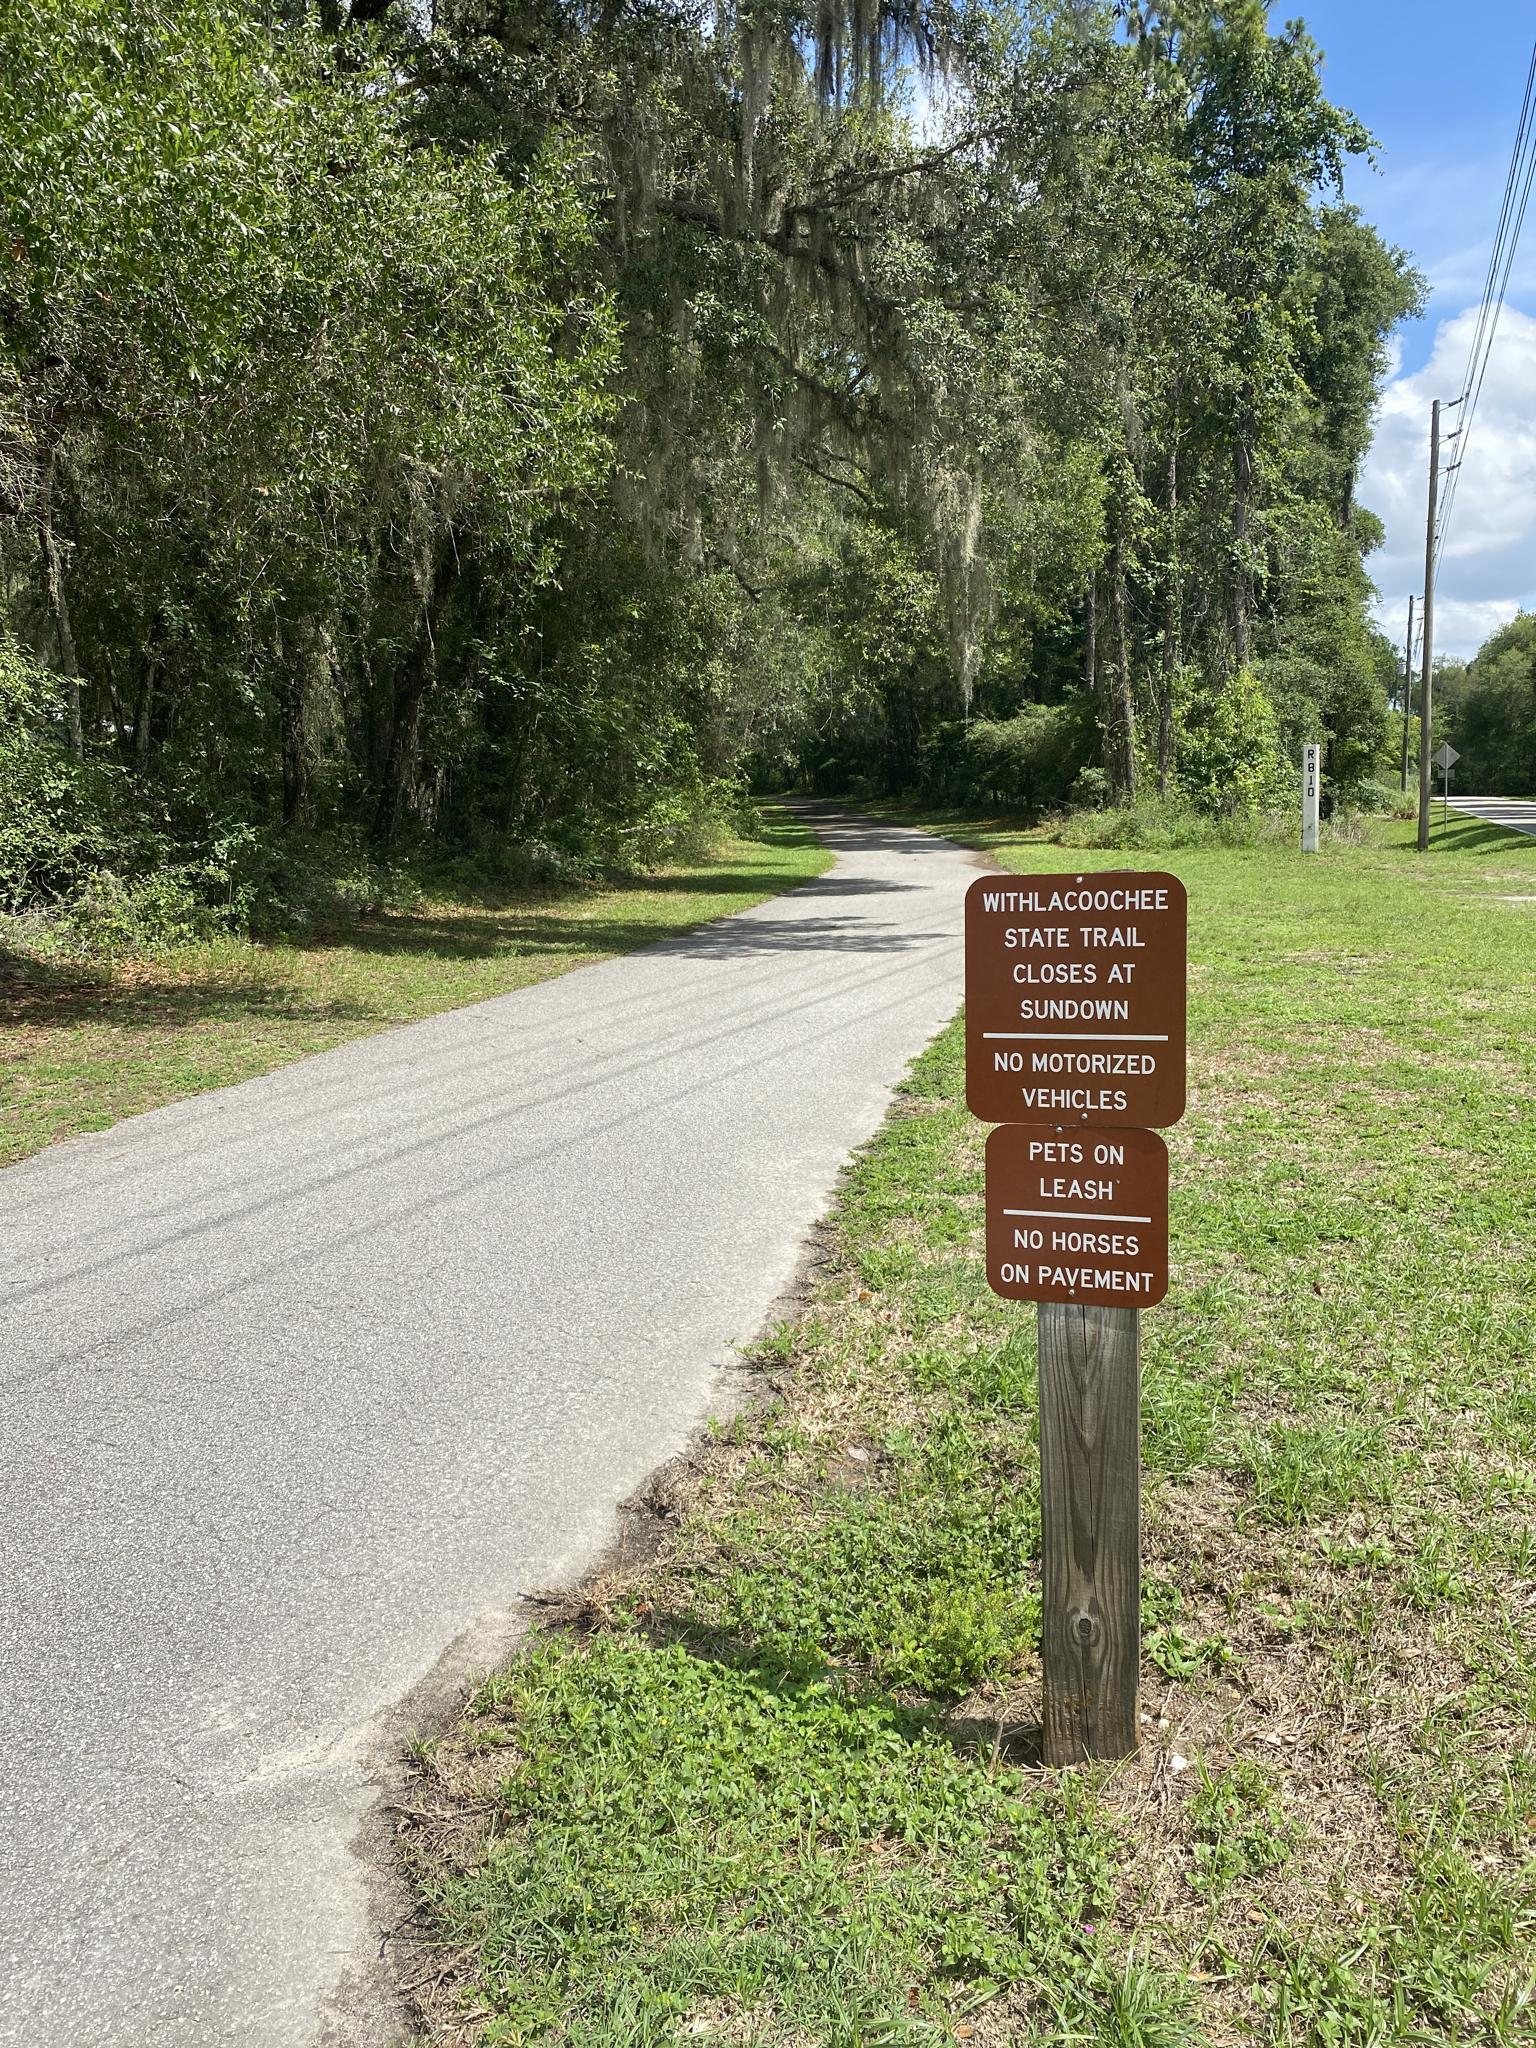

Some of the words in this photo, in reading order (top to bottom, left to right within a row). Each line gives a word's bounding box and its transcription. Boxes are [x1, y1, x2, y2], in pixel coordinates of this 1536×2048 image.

[983, 890, 1168, 912] WITHLACOOCHEE
[1005, 928, 1069, 947] STATE
[1080, 927, 1145, 947] TRAIL
[1014, 964, 1096, 983] CLOSES
[1108, 964, 1135, 983] AT
[1021, 1000, 1128, 1019] SUNDOWN
[995, 1053, 1023, 1071] NO
[1033, 1053, 1155, 1074] MOTORIZED
[1022, 1088, 1127, 1110] VEHICLES
[1030, 1142, 1083, 1163] PETS
[1094, 1145, 1123, 1165] ON
[1040, 1177, 1112, 1200] LEASH
[1015, 1229, 1043, 1249] NO
[1053, 1232, 1139, 1255] HORSES
[1001, 1263, 1029, 1283] ON
[1039, 1266, 1153, 1292] PAVEMENT
